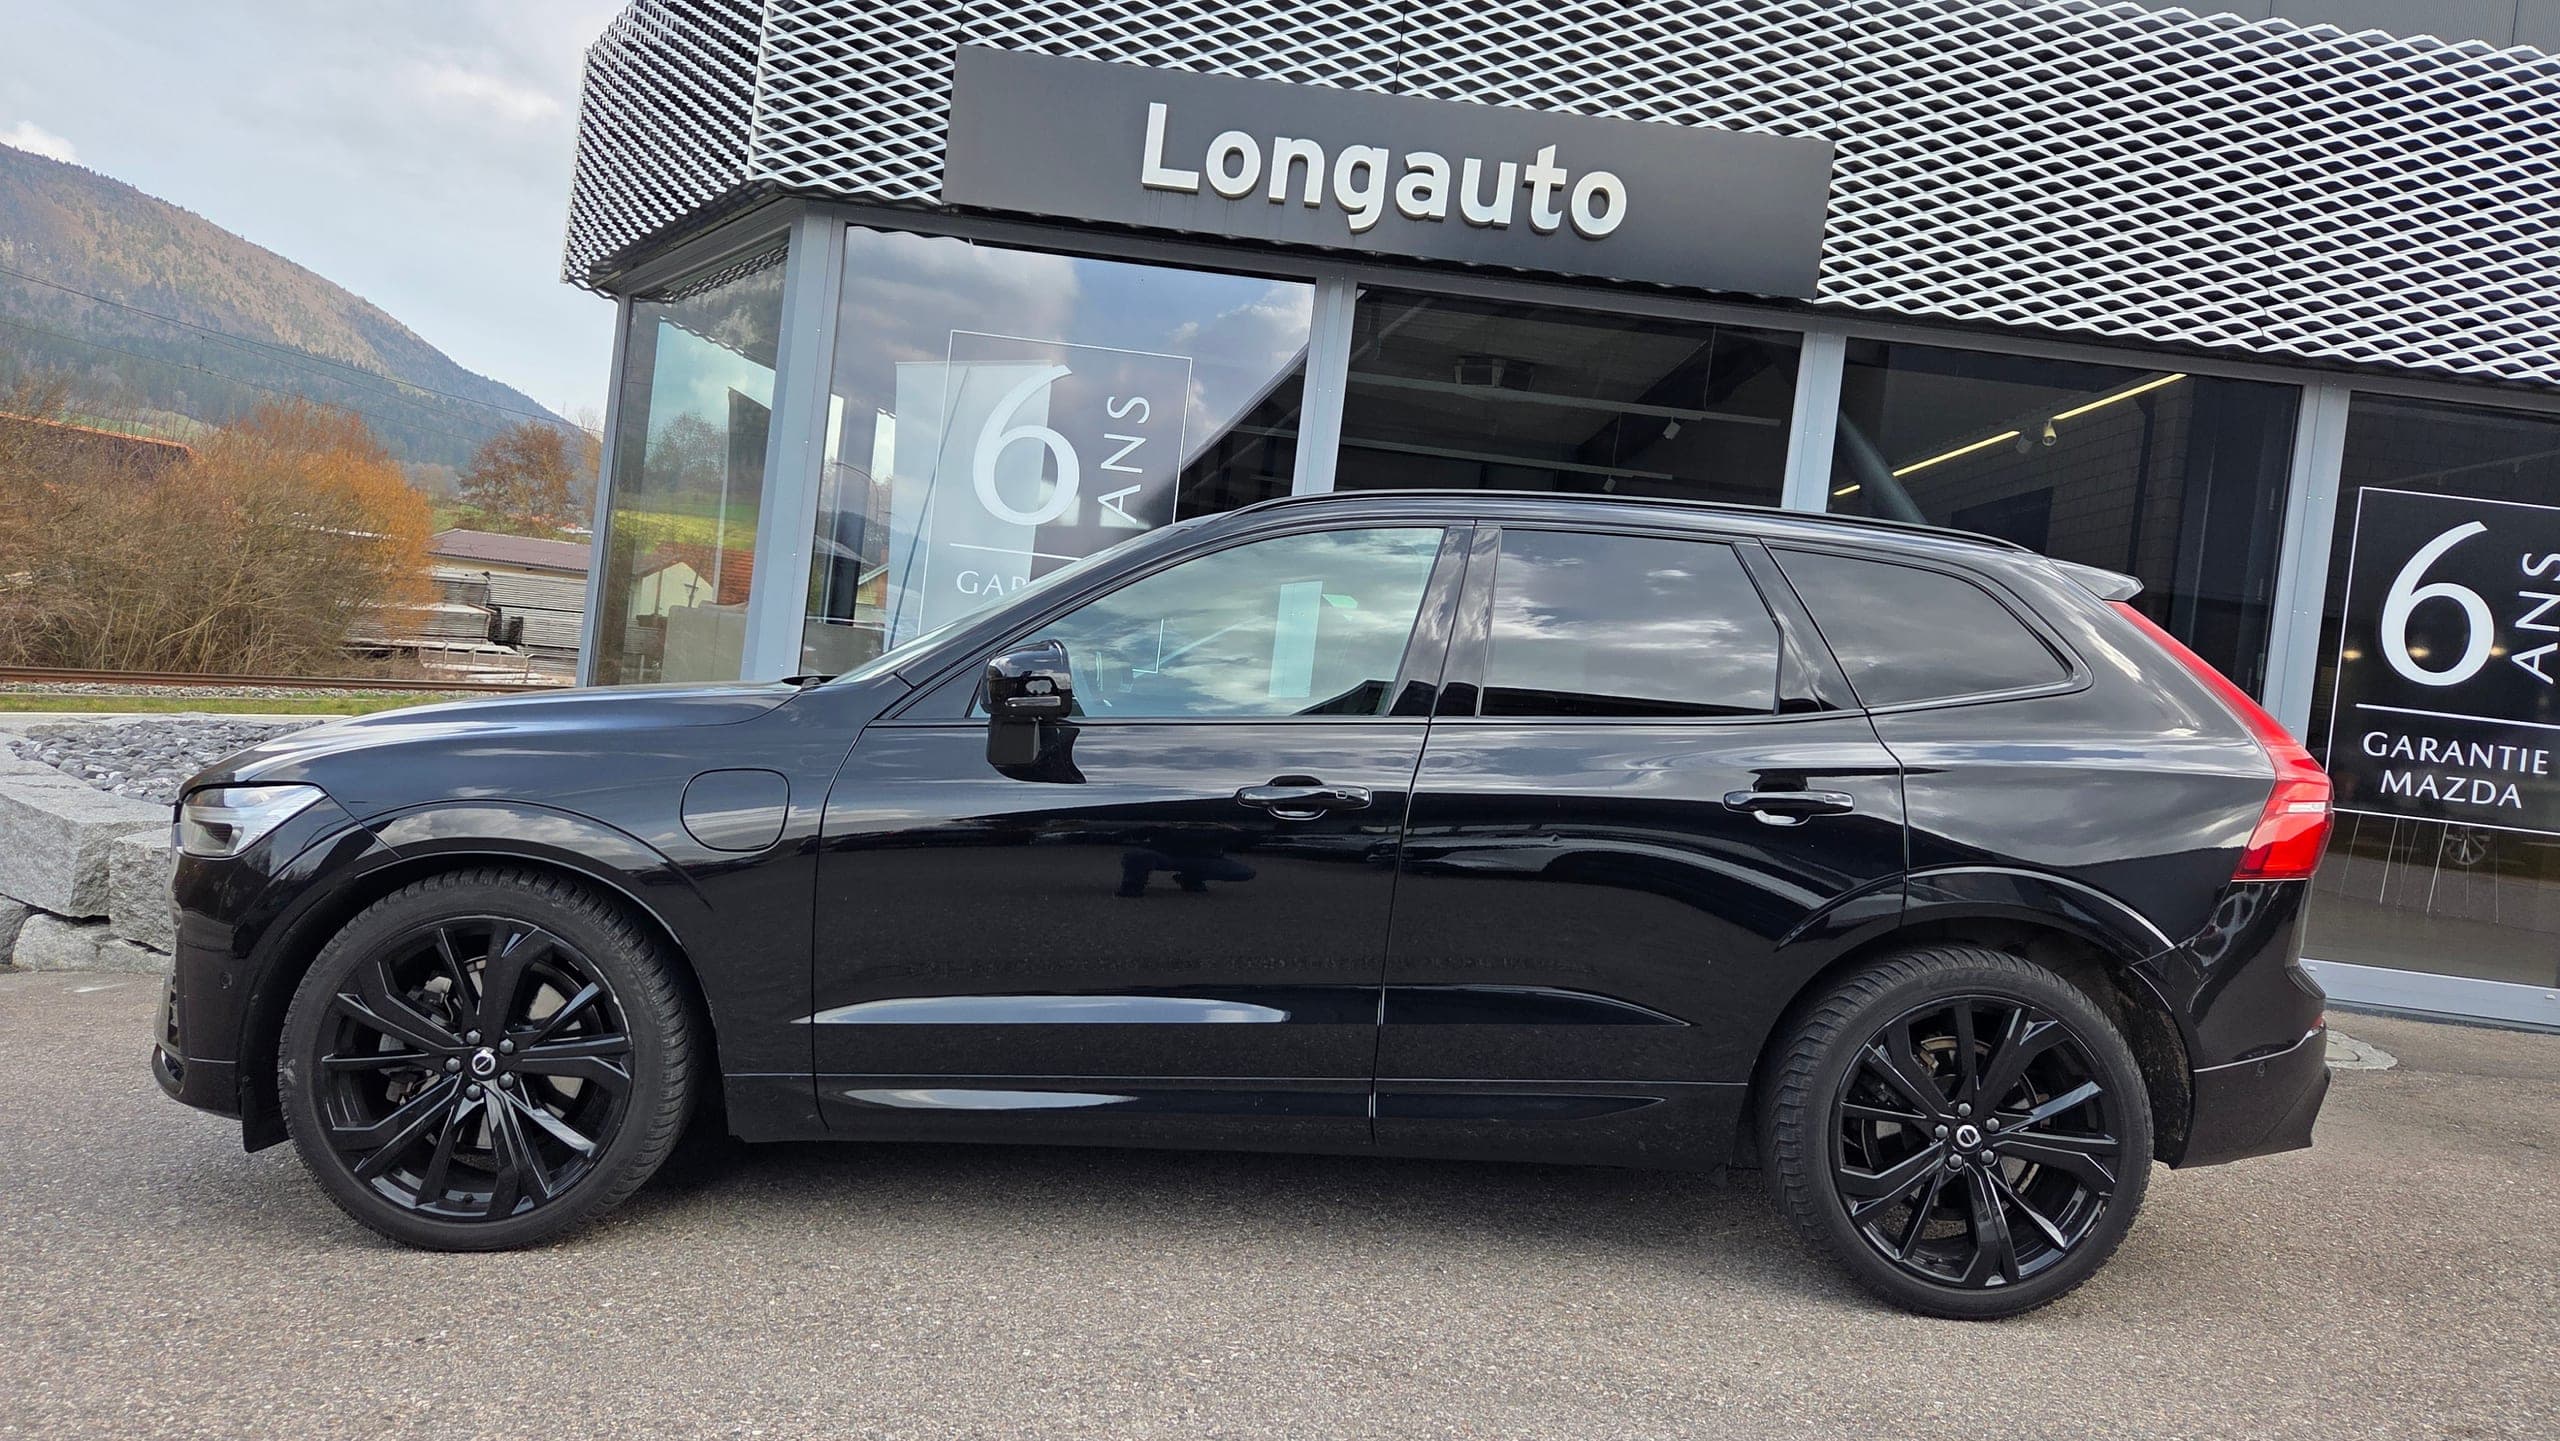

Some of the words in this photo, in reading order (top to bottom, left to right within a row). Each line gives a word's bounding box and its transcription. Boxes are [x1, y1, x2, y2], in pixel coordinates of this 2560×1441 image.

[1141, 102, 1628, 239] Longauto
[972, 364, 1081, 527] 6
[1097, 395, 1151, 525] ANS
[2380, 520, 2495, 687] 6
[2511, 552, 2560, 685] ANS
[2362, 730, 2550, 776] GARANTIE
[2379, 769, 2523, 810] MAZDA
